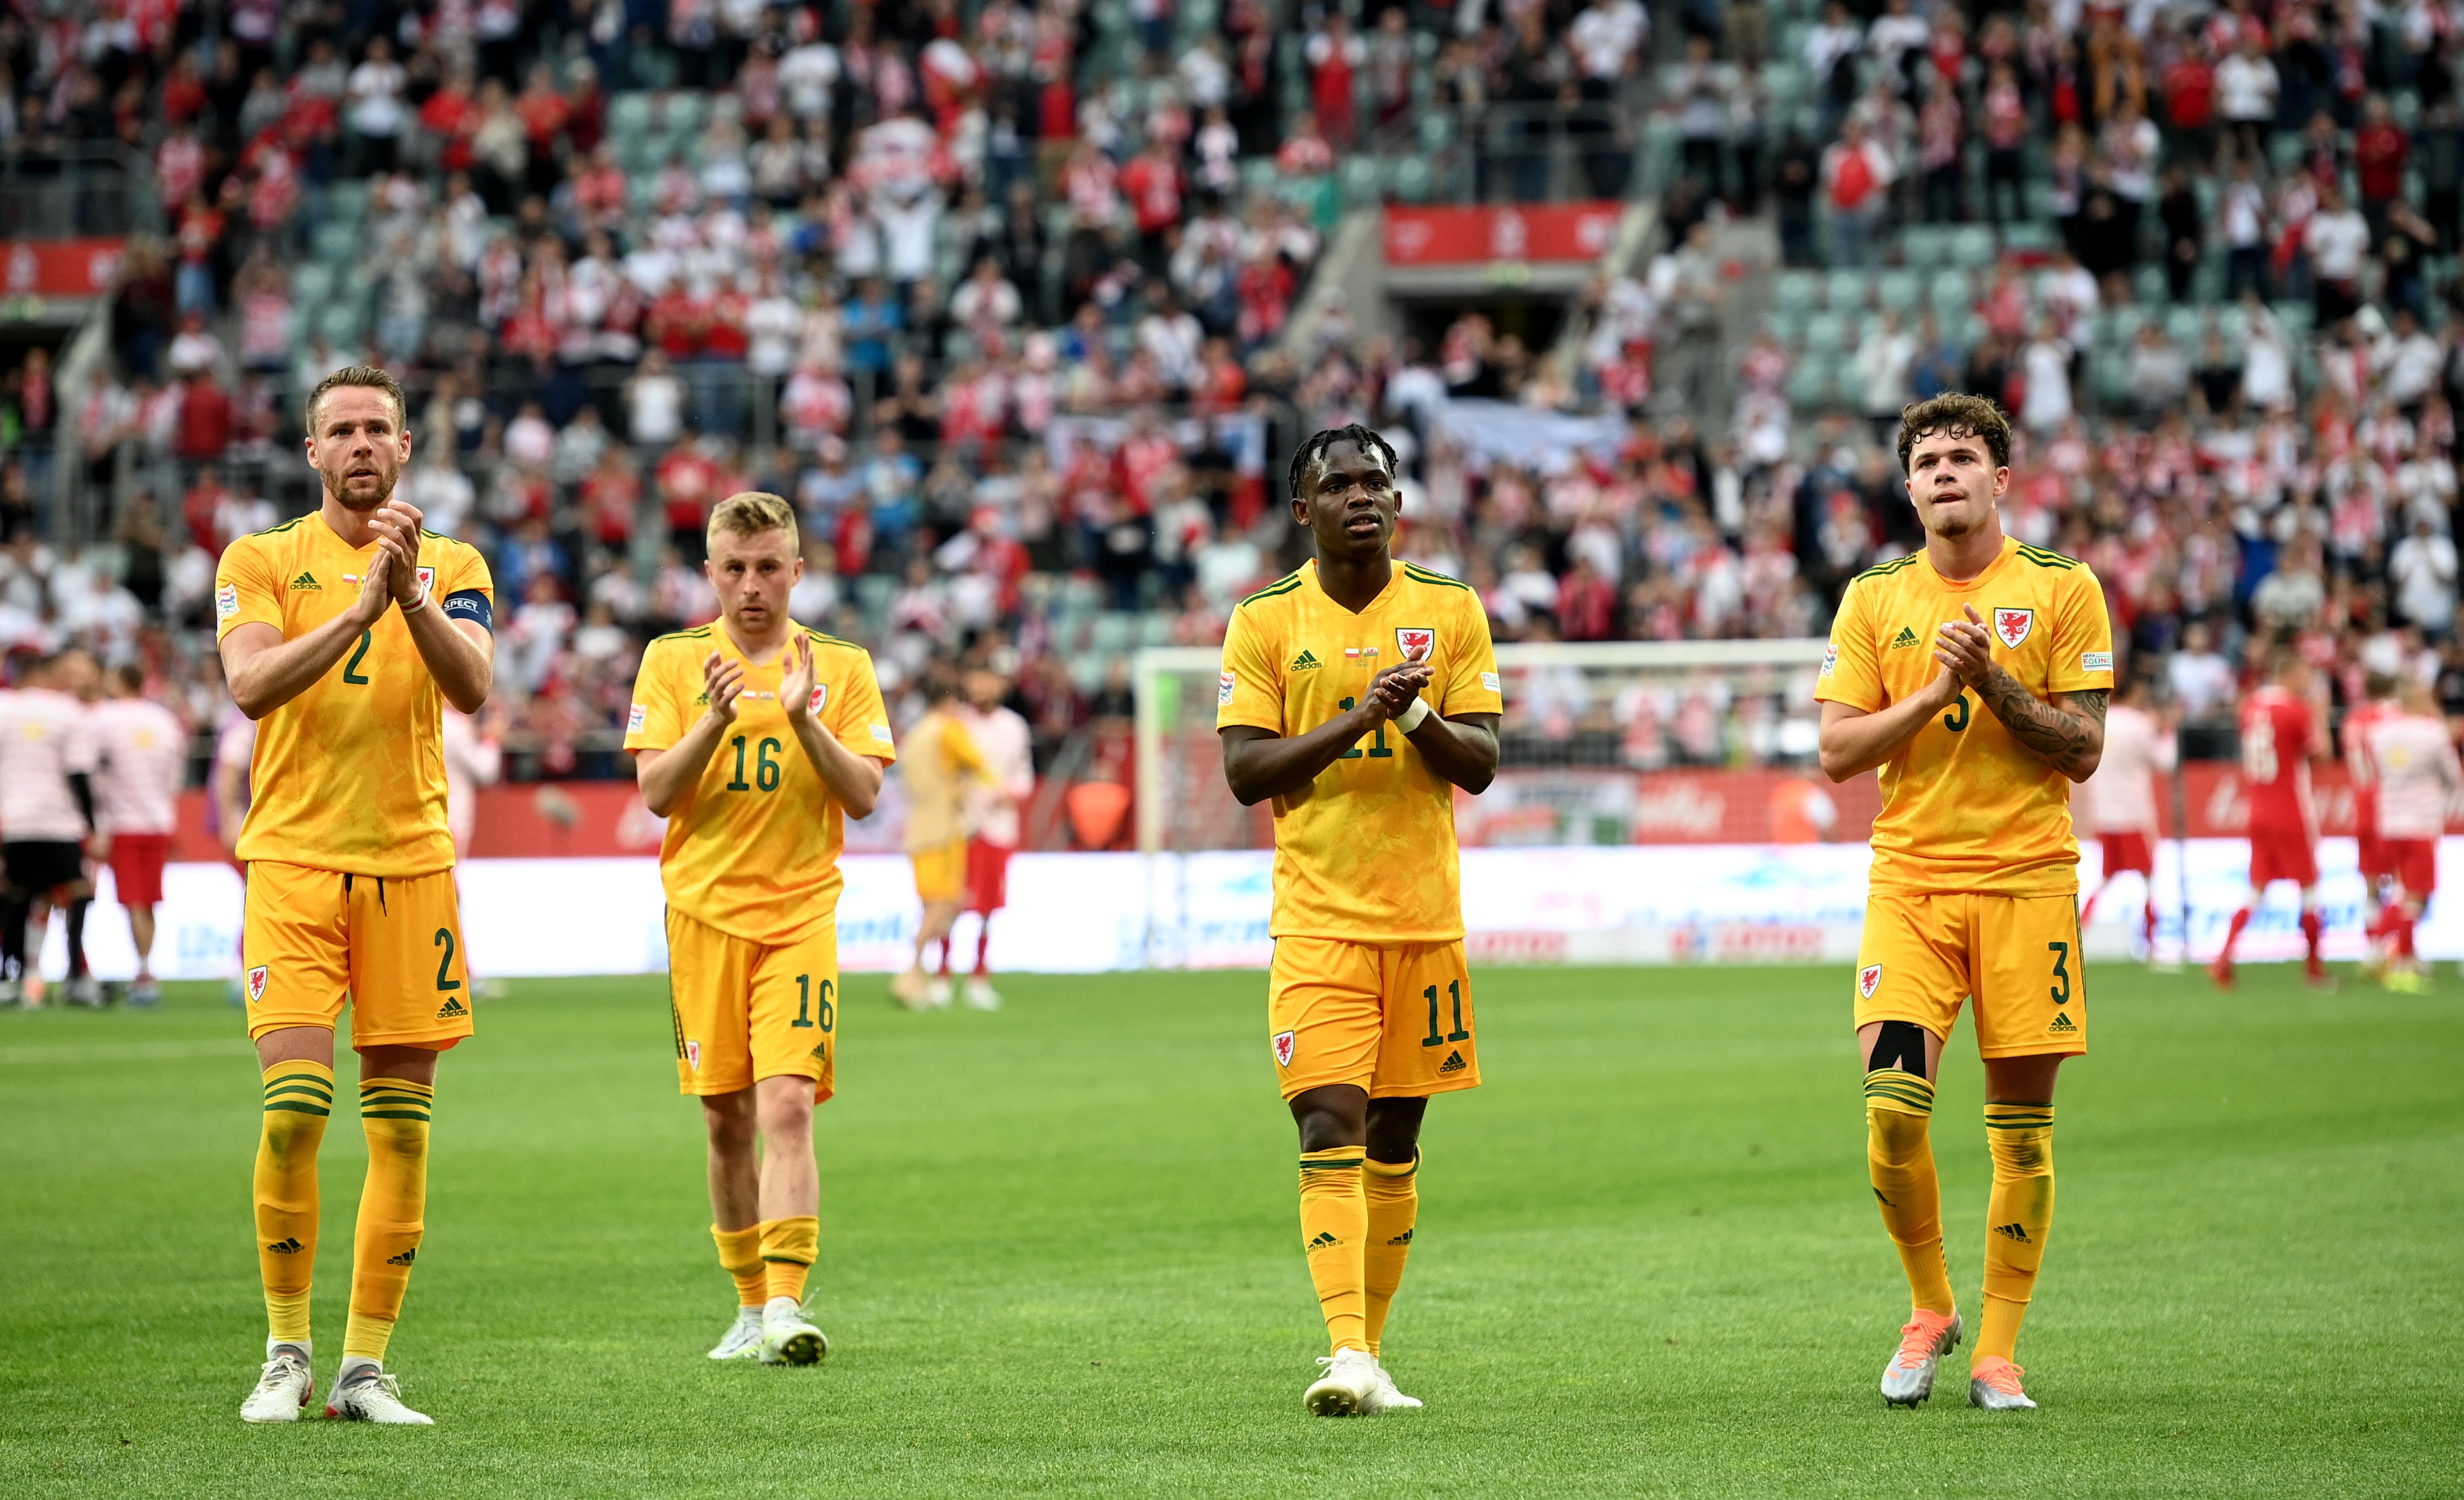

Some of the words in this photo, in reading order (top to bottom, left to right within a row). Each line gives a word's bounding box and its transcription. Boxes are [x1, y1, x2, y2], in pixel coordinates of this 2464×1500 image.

[444, 600, 478, 610] SPECT
[1892, 639, 1920, 649] adidas
[344, 629, 371, 685] 2
[1291, 662, 1322, 672] adidas
[728, 737, 781, 791] 16
[436, 928, 460, 990] 2
[2050, 943, 2069, 1003] 3
[792, 974, 833, 1033] 16
[437, 1009, 468, 1018] adidas
[1422, 980, 1469, 1046] 11
[1439, 1062, 1467, 1072] adidas
[1993, 1228, 2032, 1243] adidas
[267, 1245, 305, 1254] adidas
[1307, 1240, 1344, 1255] adidas
